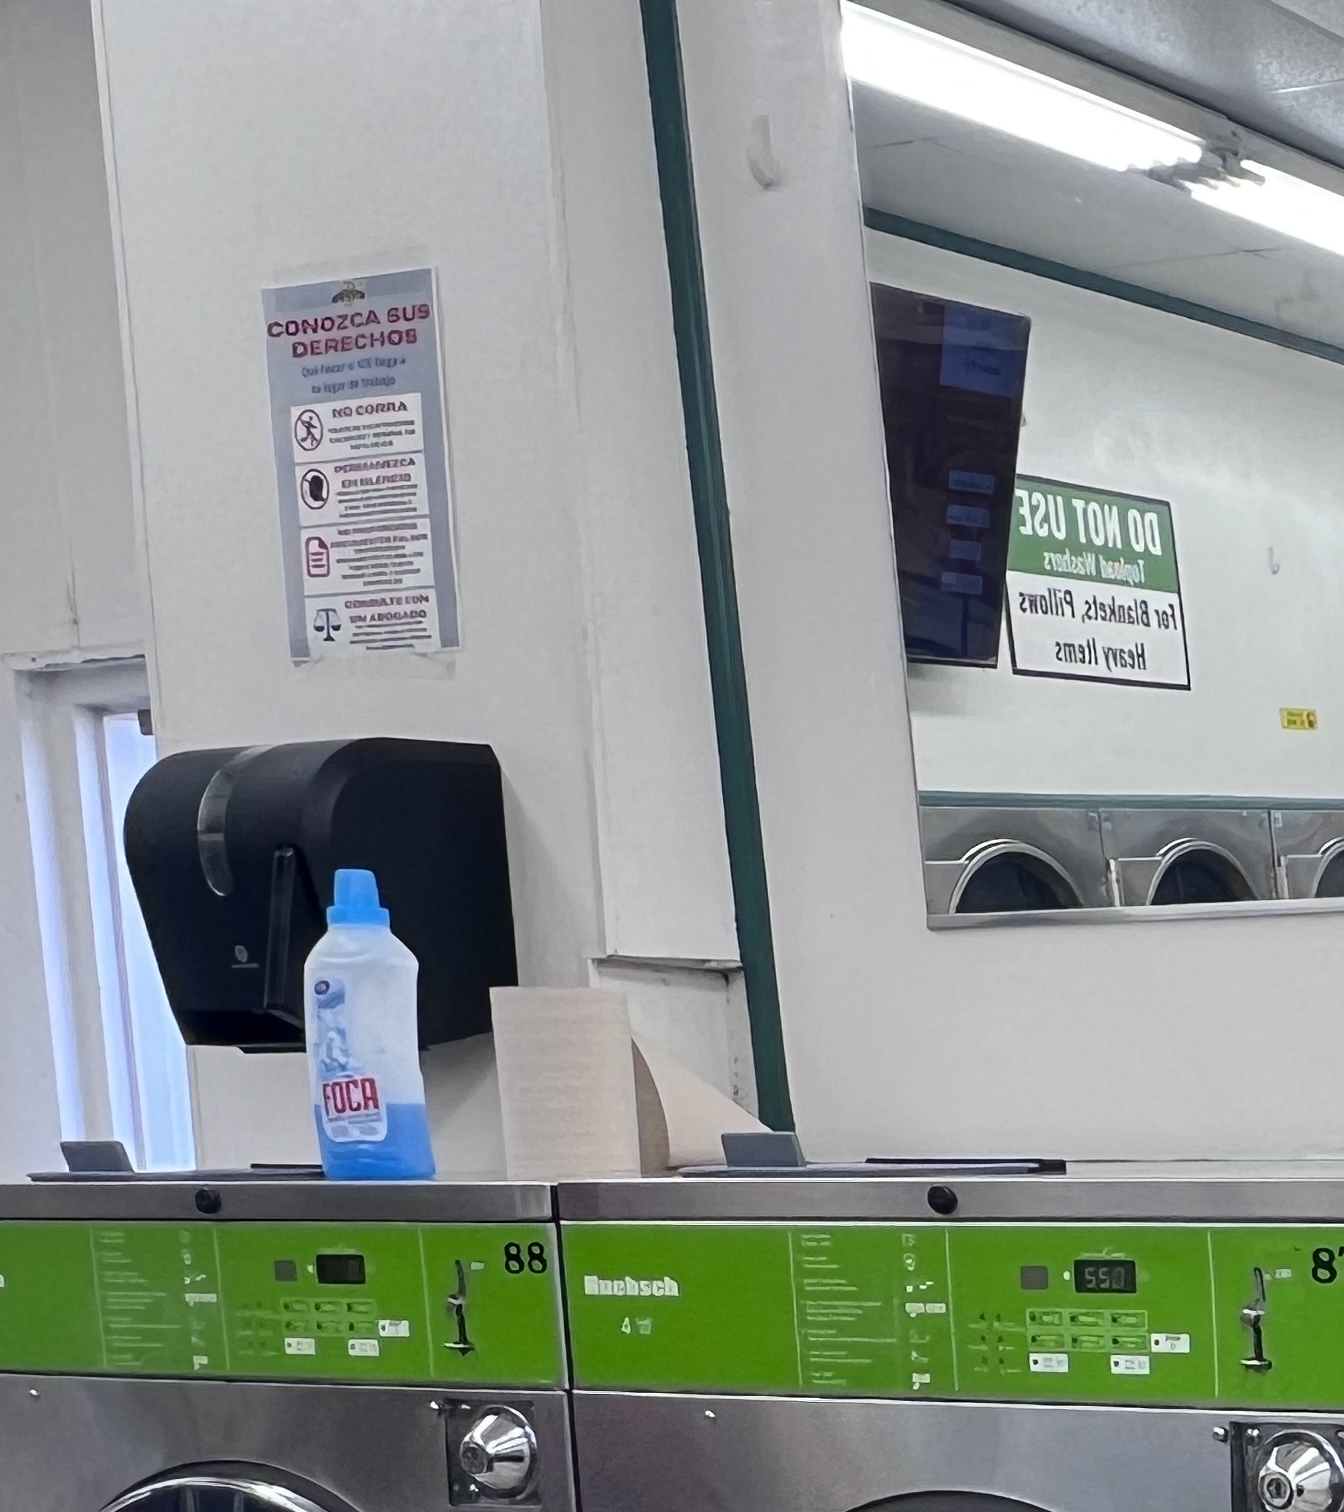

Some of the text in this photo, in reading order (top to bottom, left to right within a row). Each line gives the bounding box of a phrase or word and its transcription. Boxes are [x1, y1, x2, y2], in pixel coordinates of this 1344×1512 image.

[267, 303, 430, 337] CONOZCA SUS
[292, 328, 417, 358] DERECHOS
[332, 401, 408, 418] NO CORRA
[323, 1077, 380, 1118] FOCA
[503, 1241, 548, 1275] 88
